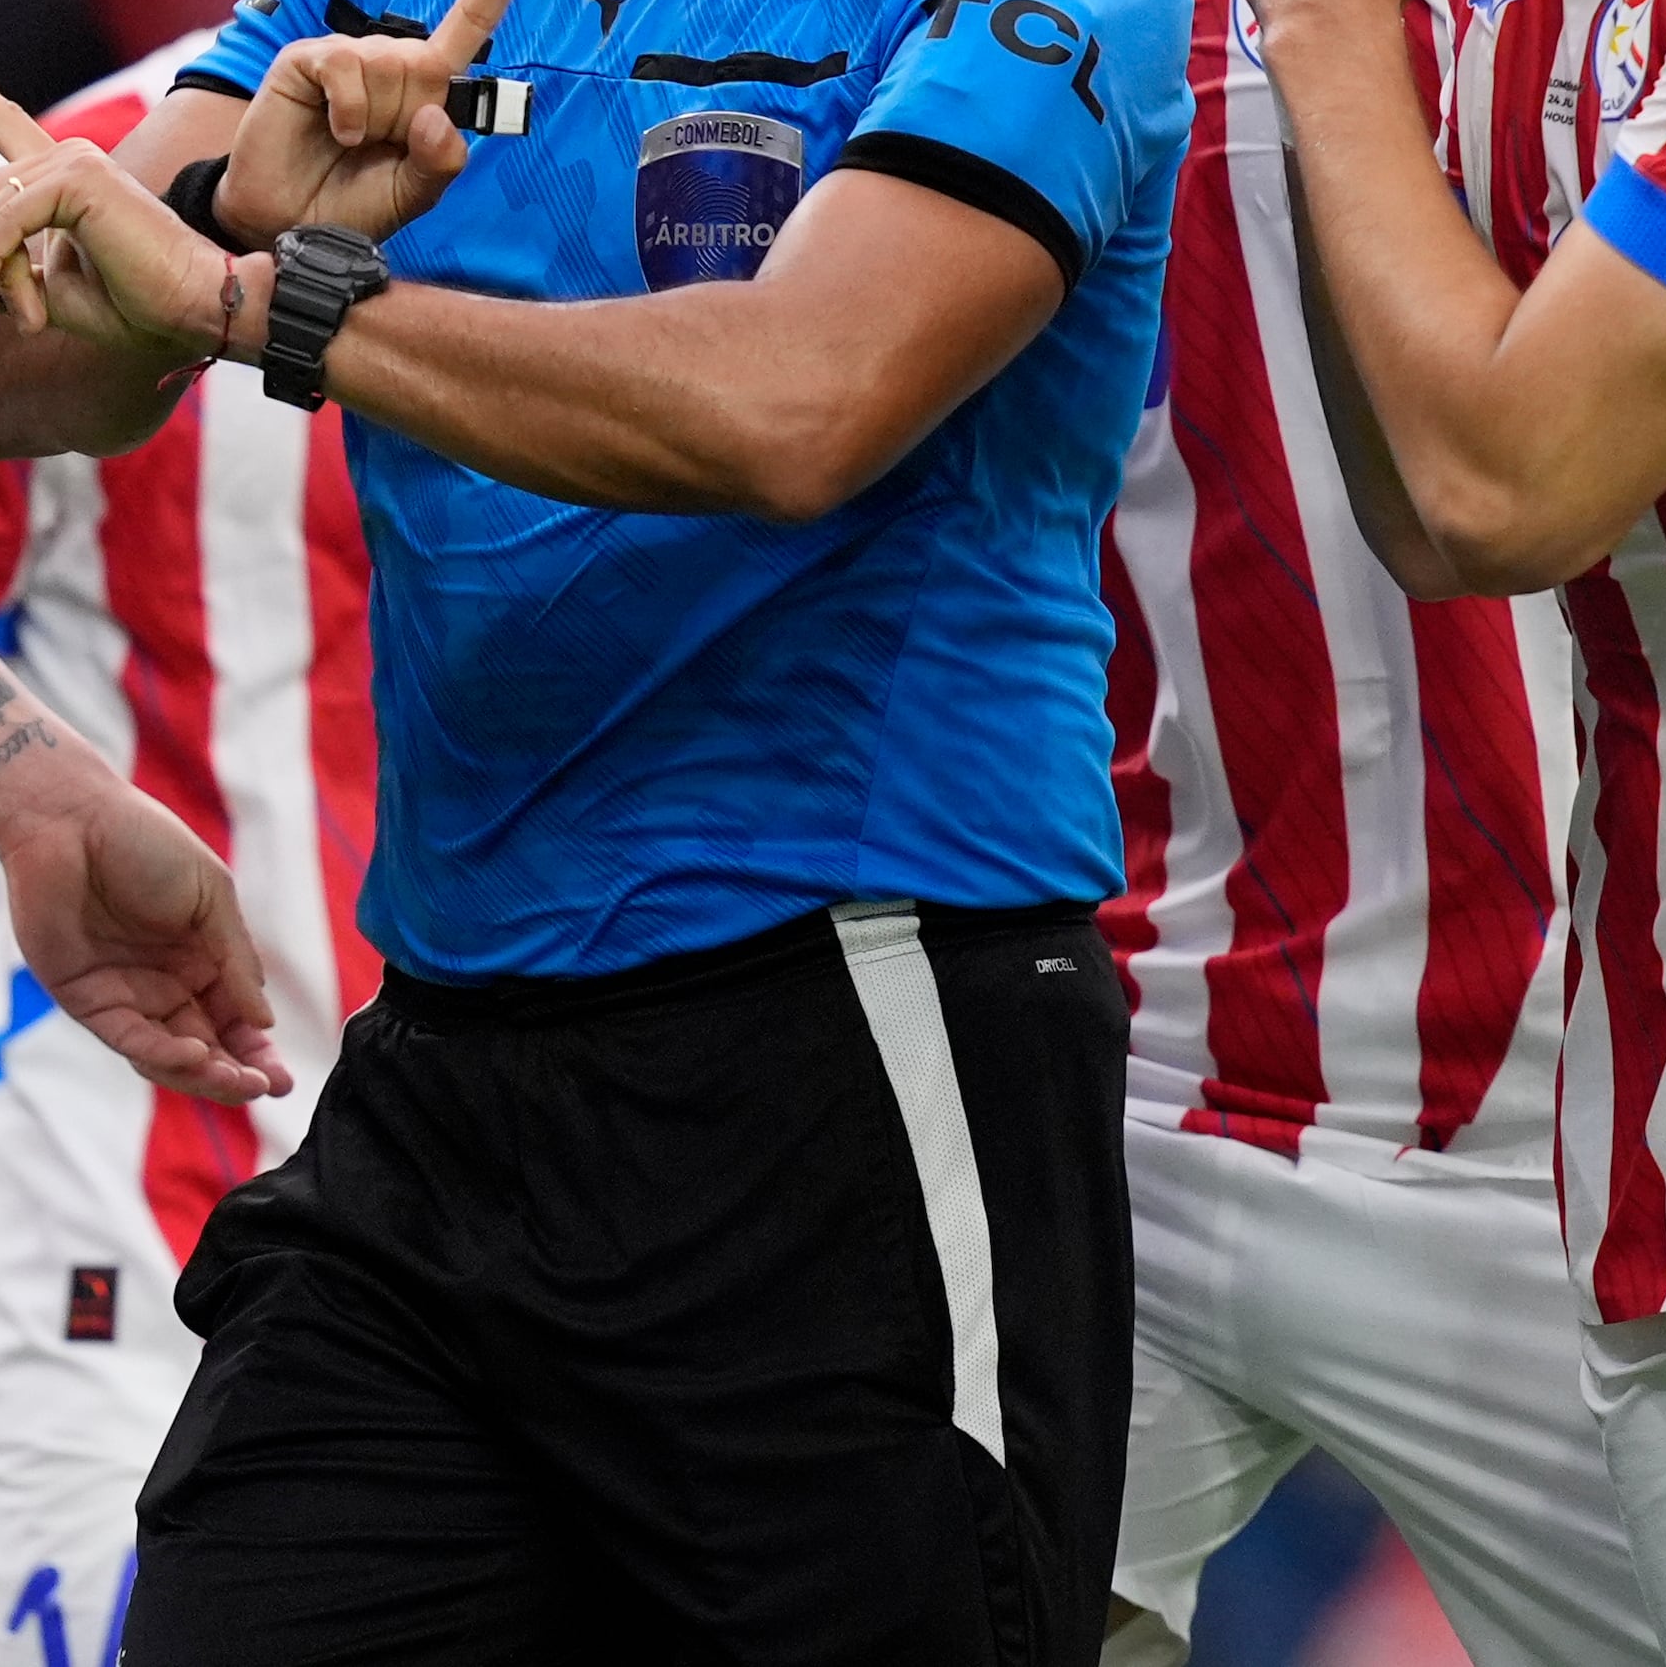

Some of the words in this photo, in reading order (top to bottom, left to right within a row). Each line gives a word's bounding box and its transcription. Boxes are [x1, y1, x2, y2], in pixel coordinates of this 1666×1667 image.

[1547, 94, 1560, 105] 24
[674, 120, 764, 147] CONMEBOL
[654, 215, 776, 247] ÁRBITRO
[1035, 957, 1078, 974] DRYCELL
